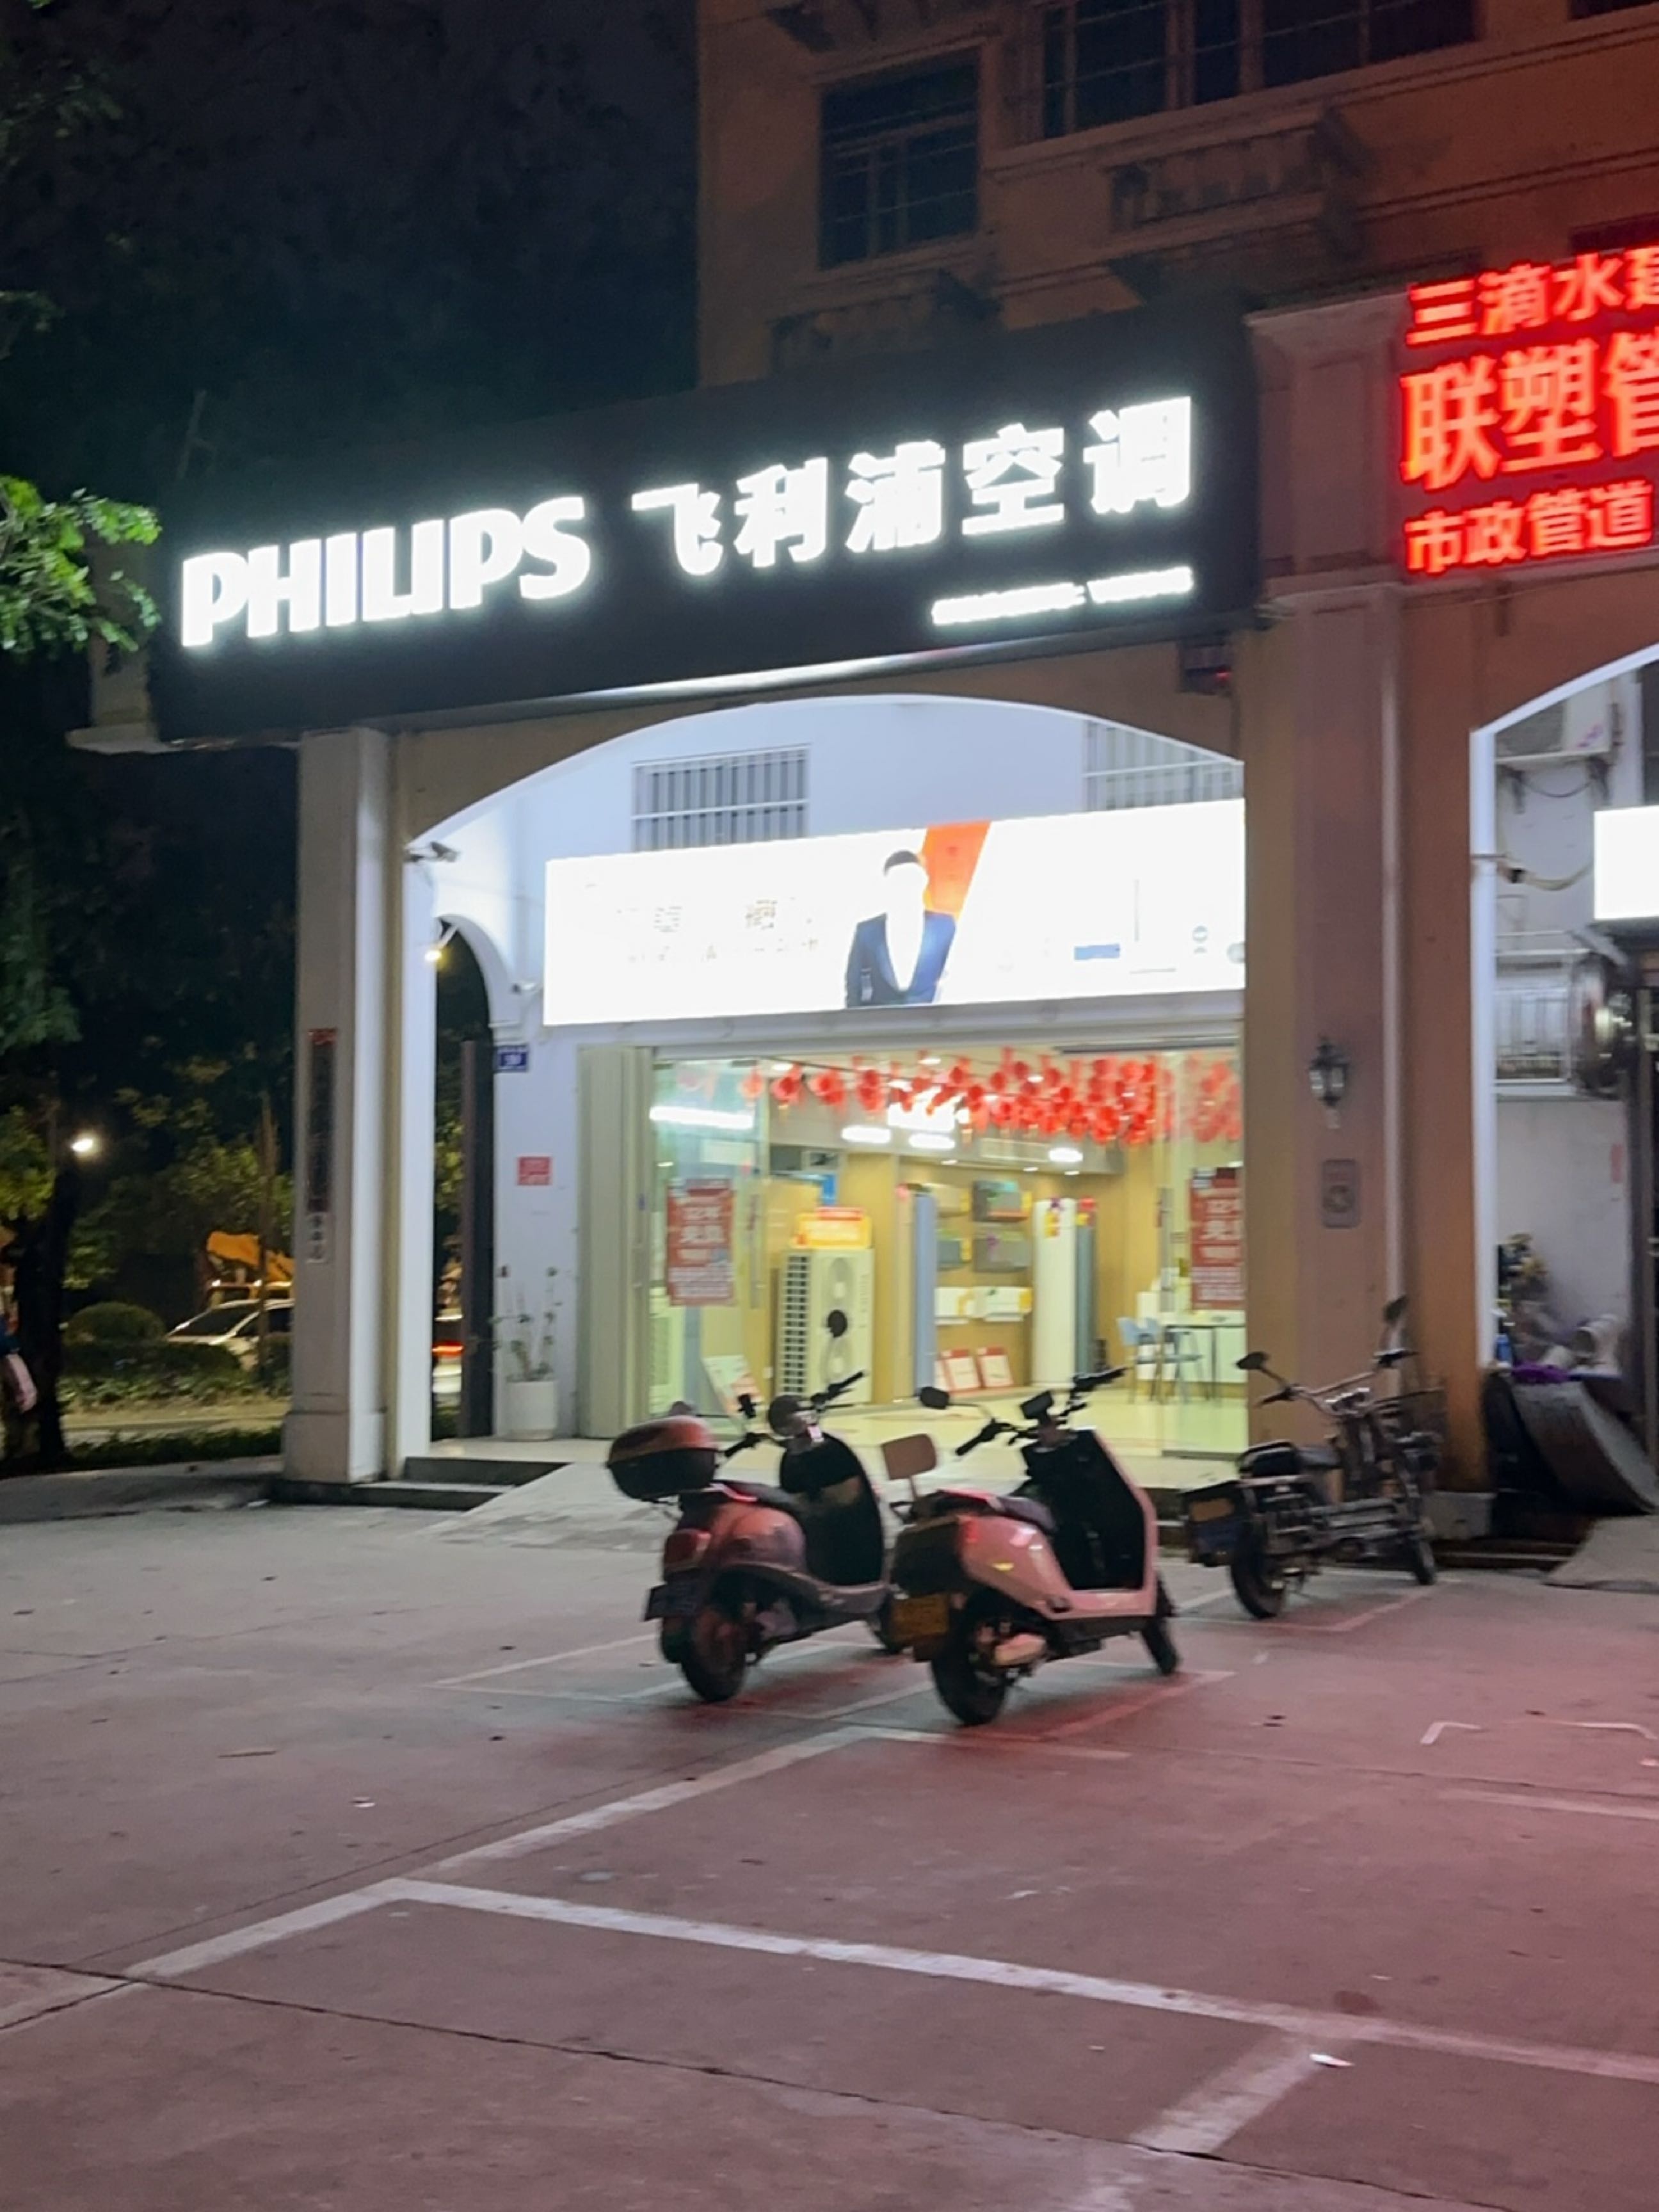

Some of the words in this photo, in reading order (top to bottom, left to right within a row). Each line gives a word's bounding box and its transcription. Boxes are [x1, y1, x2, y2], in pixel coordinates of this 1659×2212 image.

[632, 396, 1191, 575] 飞利浦空调
[1406, 481, 1651, 573] 市政管道
[182, 497, 591, 647] PHILIPS
